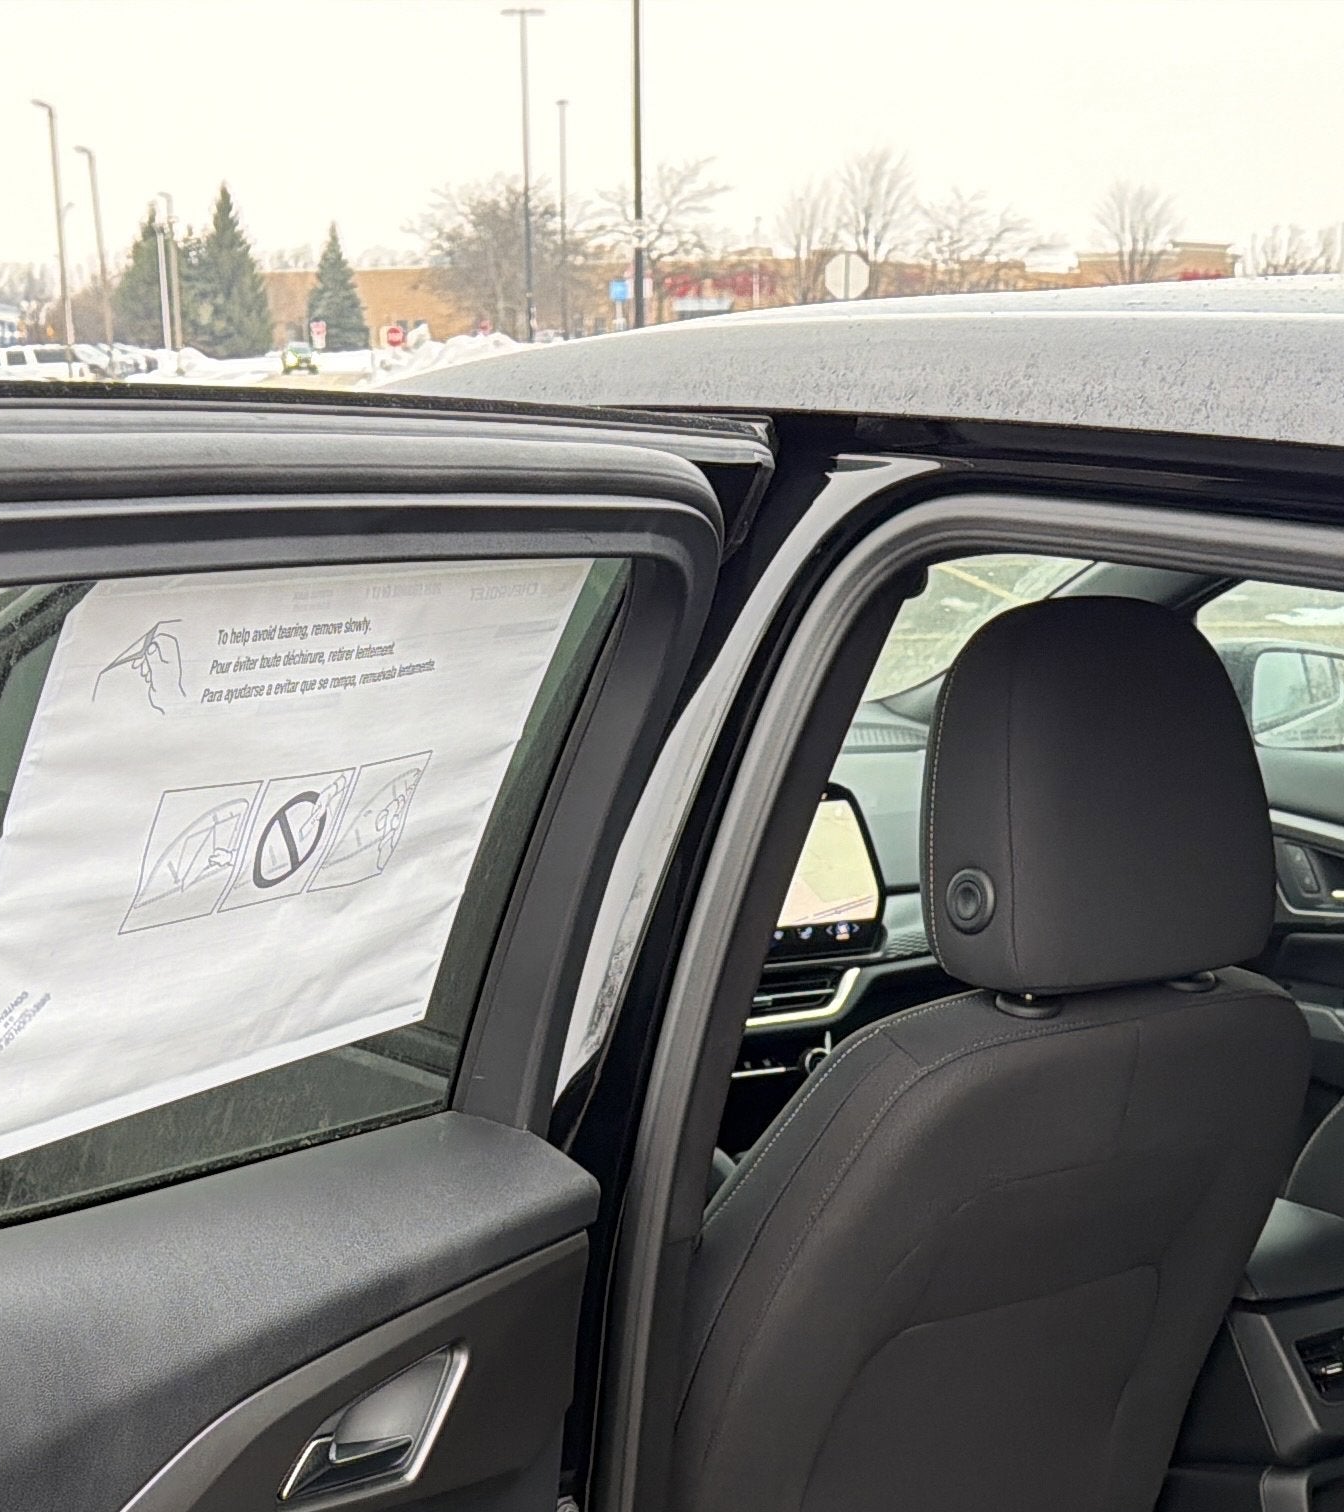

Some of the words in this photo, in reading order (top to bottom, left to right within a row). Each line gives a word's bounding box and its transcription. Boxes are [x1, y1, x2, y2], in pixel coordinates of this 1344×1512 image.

[218, 629, 228, 645] To
[230, 627, 250, 646] help
[252, 625, 277, 642] avoid
[278, 622, 308, 640] tearing,
[311, 622, 342, 636] remove
[344, 616, 371, 635] slowly.
[209, 660, 232, 675] Pour
[233, 656, 259, 672] éviter
[259, 652, 281, 669] toute
[283, 650, 325, 666] déchirure,
[327, 647, 354, 662] retirer
[201, 688, 223, 703] Para
[224, 684, 265, 703] ayudarse
[266, 684, 273, 695] a
[274, 679, 300, 695] evitar
[300, 679, 316, 694] que
[317, 679, 329, 690] se
